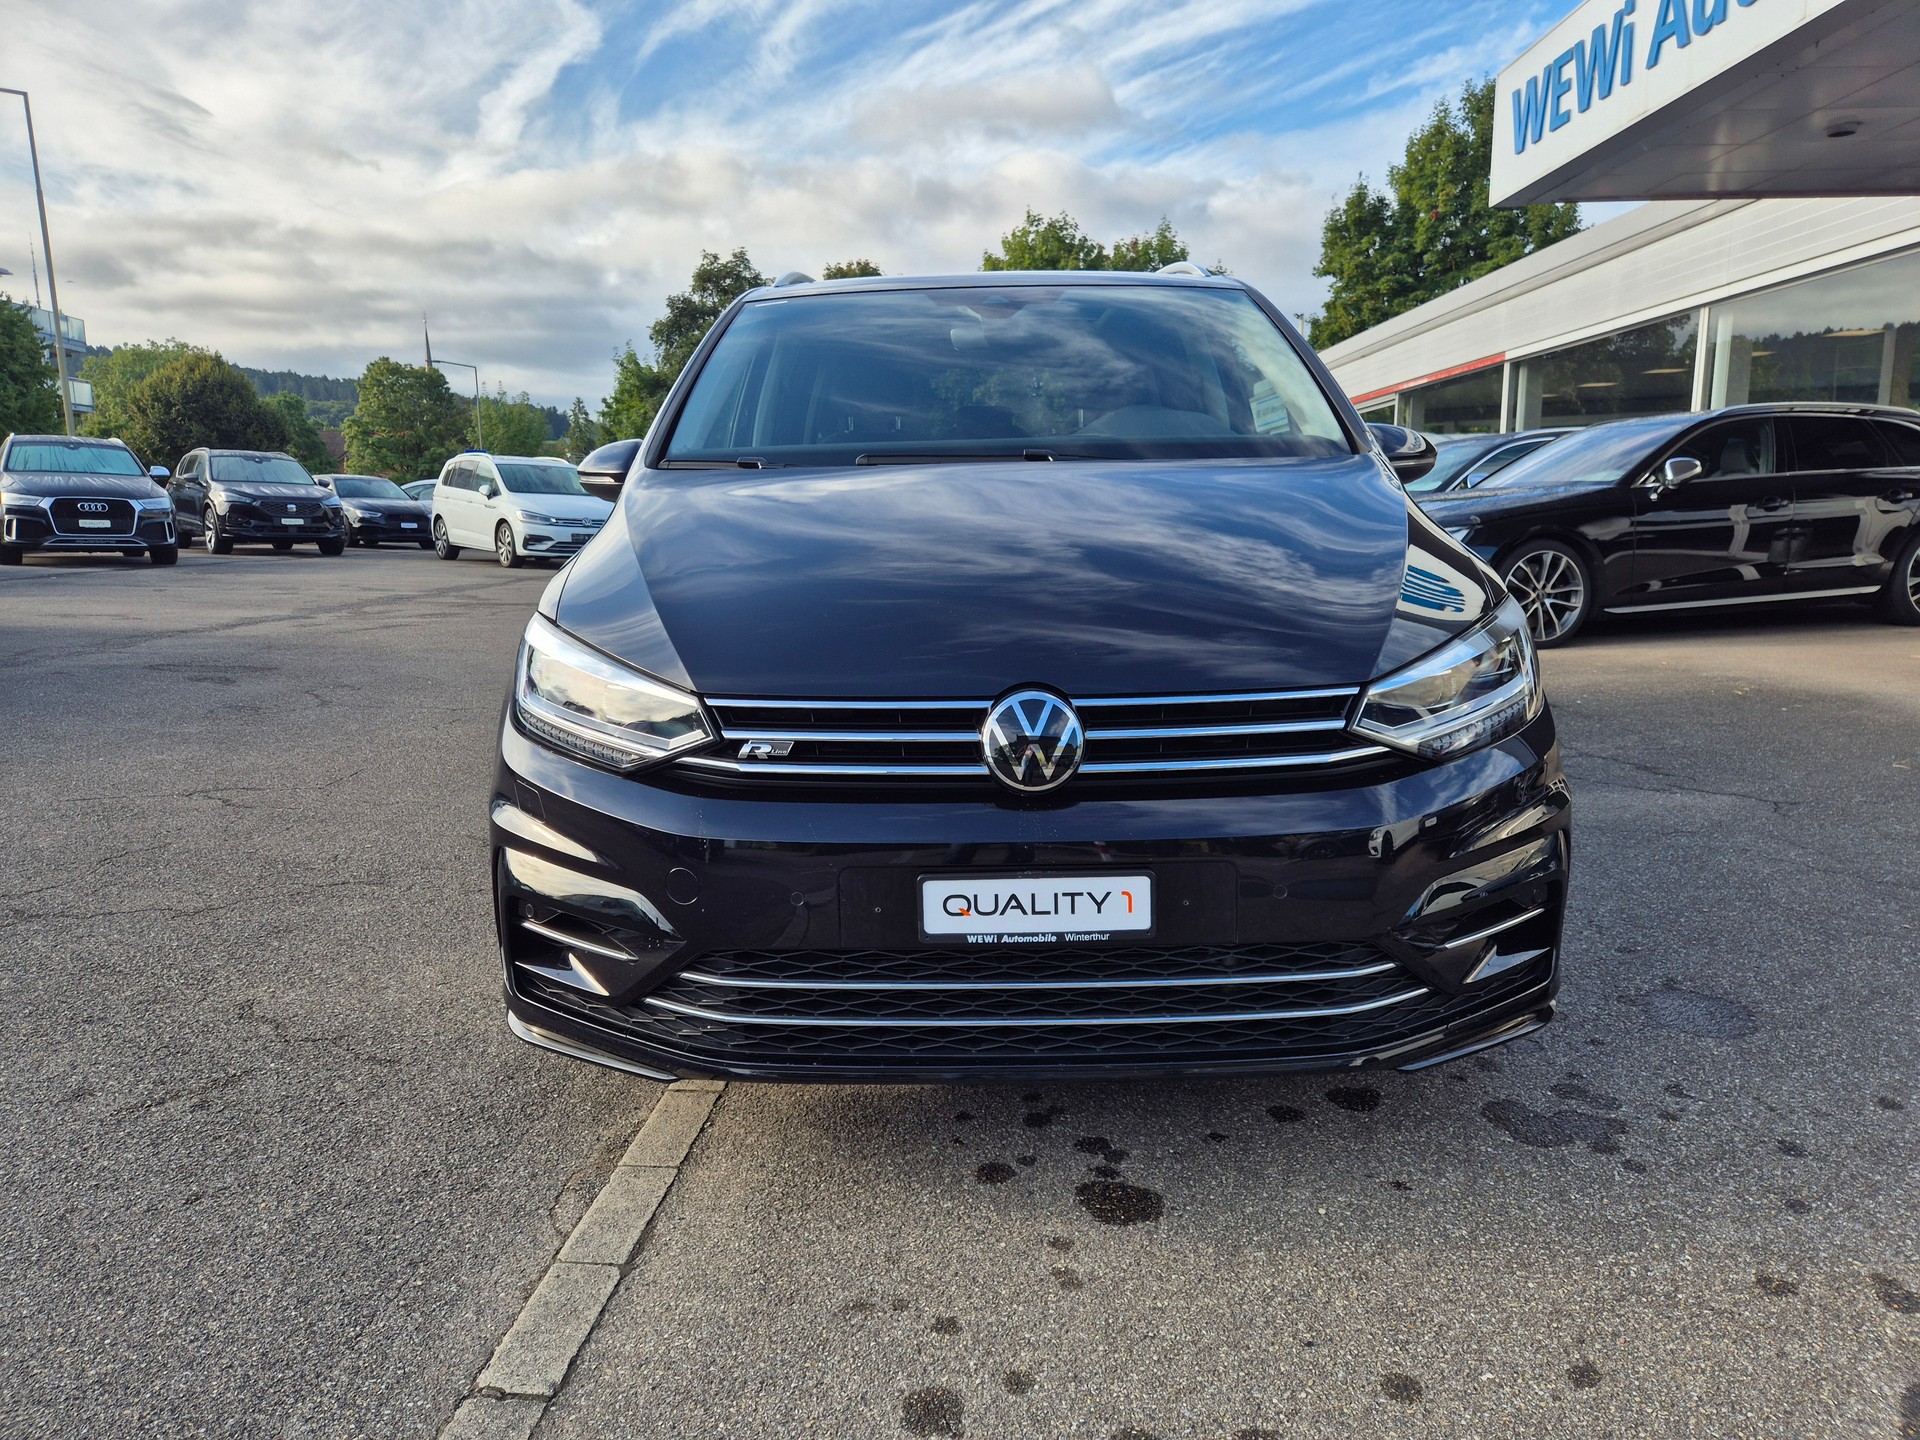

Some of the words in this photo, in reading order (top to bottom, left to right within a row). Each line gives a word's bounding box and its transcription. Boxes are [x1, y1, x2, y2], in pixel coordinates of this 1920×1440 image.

[1511, 0, 1635, 155] WEWi
[737, 743, 772, 759] R
[942, 891, 1112, 917] QUALITY
[1121, 890, 1133, 914] 1
[967, 934, 998, 944] WEWi
[1001, 933, 1057, 944] Automobile
[1064, 932, 1110, 942] Winterthur
